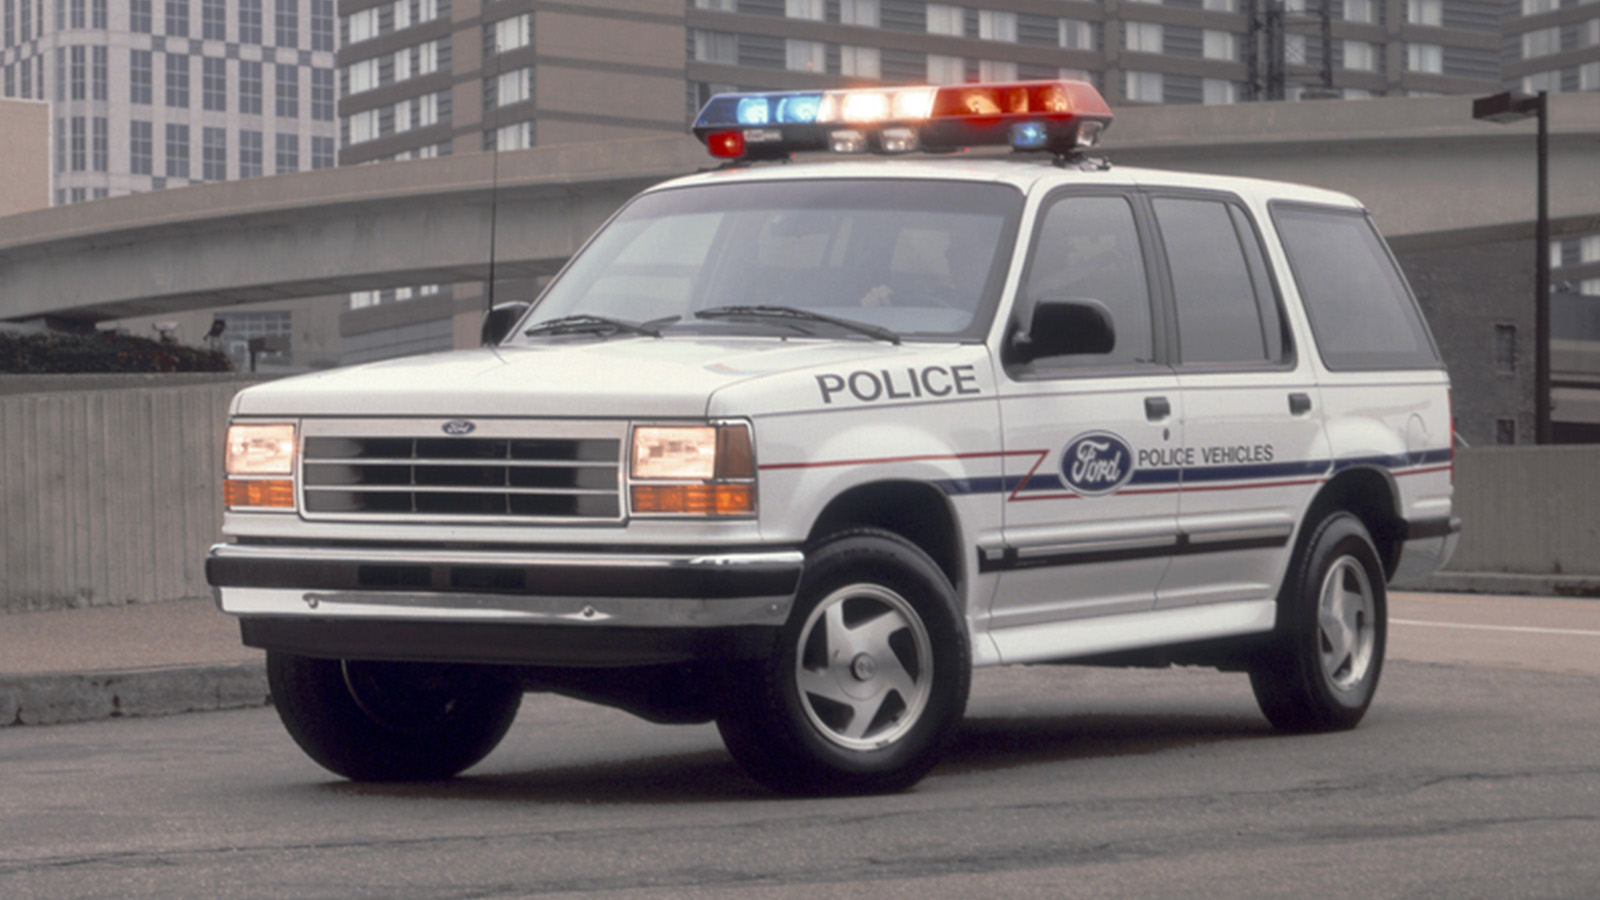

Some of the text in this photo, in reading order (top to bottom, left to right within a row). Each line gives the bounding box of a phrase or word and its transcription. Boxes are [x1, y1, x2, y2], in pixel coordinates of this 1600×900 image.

[814, 365, 981, 404] POLICE
[1071, 440, 1121, 483] Ford
[1138, 444, 1274, 467] POLICE VEHICLES
